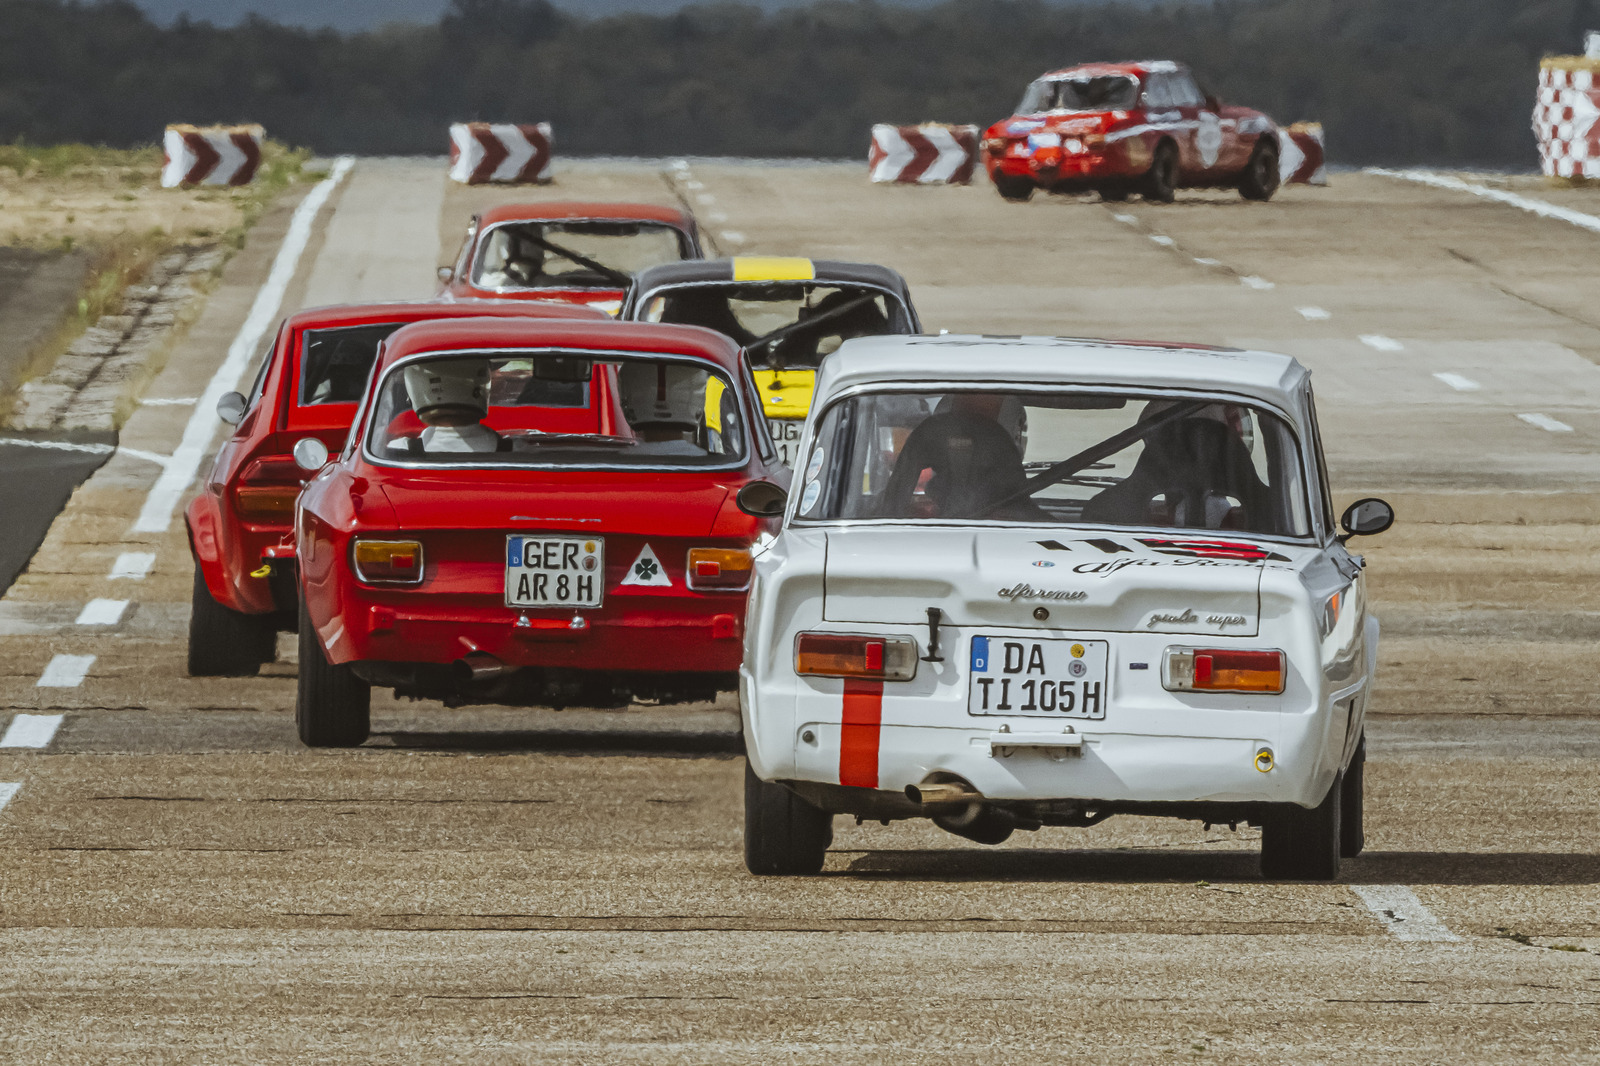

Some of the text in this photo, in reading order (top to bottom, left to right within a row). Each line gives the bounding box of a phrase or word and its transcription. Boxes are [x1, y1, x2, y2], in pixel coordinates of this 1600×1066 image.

[523, 541, 579, 570] GER
[517, 573, 548, 601] AR
[1205, 614, 1247, 631] super
[975, 658, 984, 668] D
[1003, 641, 1046, 675] DA
